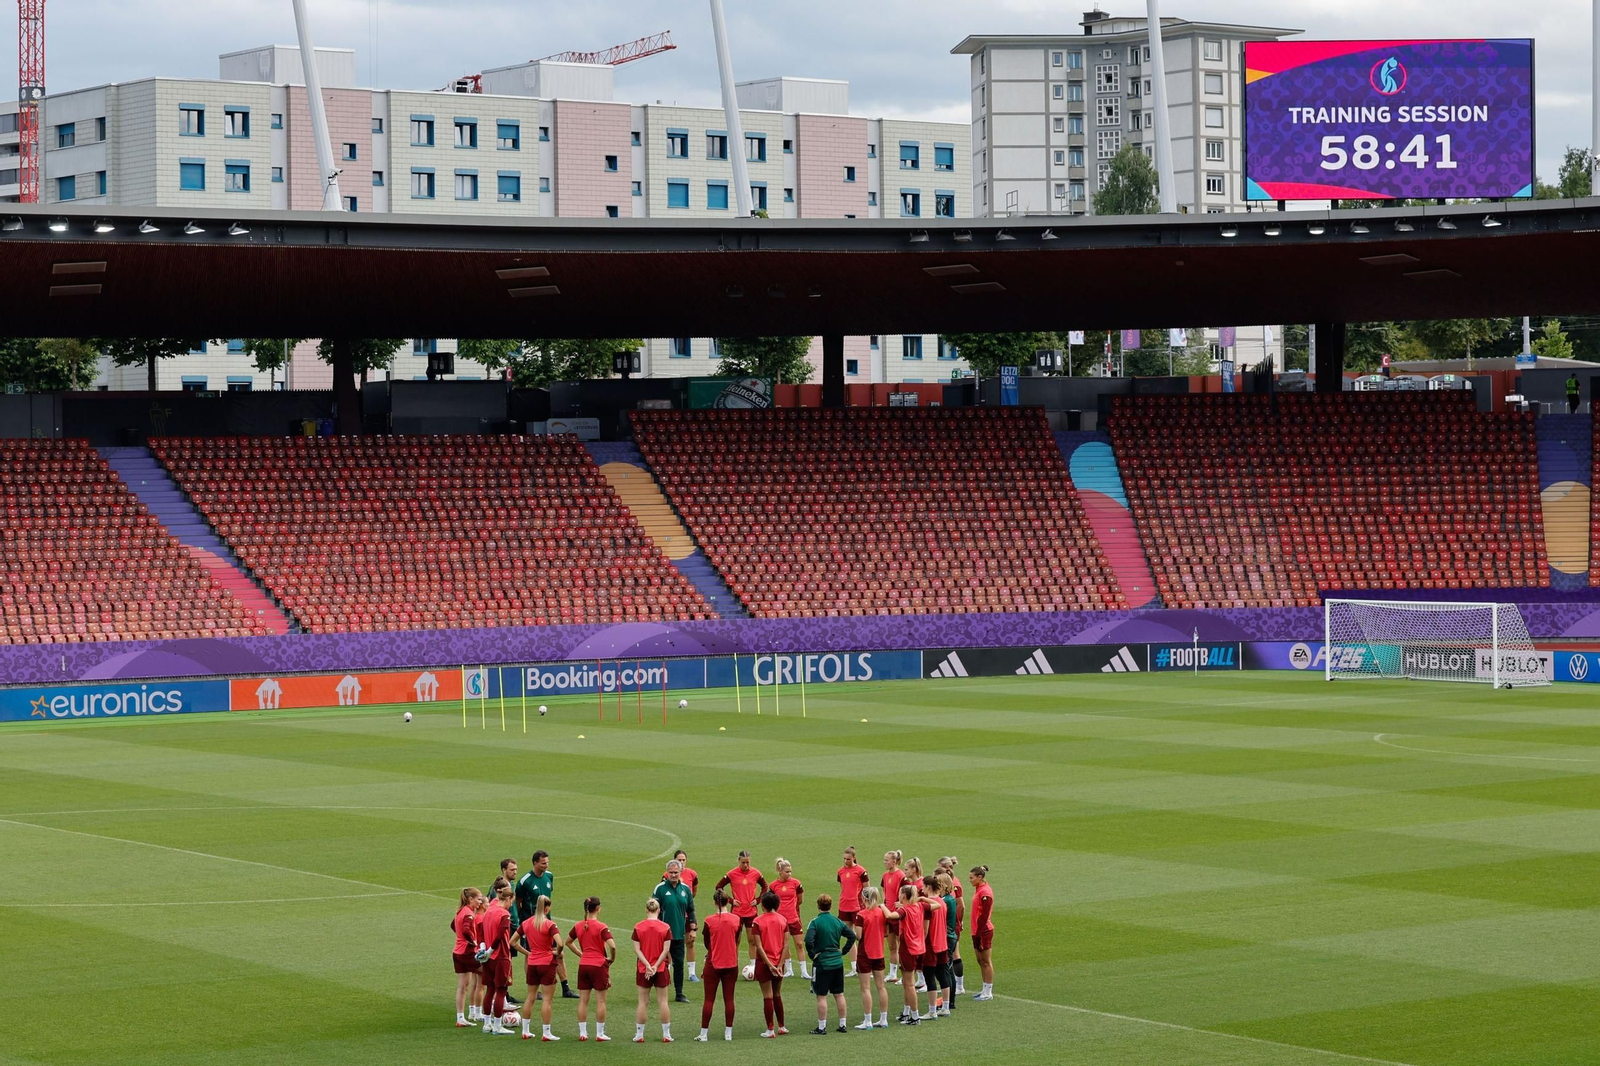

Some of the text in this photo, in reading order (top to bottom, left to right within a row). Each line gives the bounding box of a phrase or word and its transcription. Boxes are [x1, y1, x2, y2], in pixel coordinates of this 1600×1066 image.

[1288, 105, 1488, 124] TRAINING SESSION
[1320, 134, 1457, 170] 58:41
[1382, 356, 1388, 366] C
[1001, 366, 1018, 376] LETZI
[1001, 376, 1015, 385] DOG
[725, 384, 768, 408] Heineken
[1155, 647, 1234, 667] #FOOTBALL
[1293, 649, 1308, 657] EA
[1406, 653, 1470, 670] HUBLOT
[526, 664, 668, 692] Booking.com
[753, 652, 873, 685] GRIFOLS
[50, 685, 183, 718] euronics
